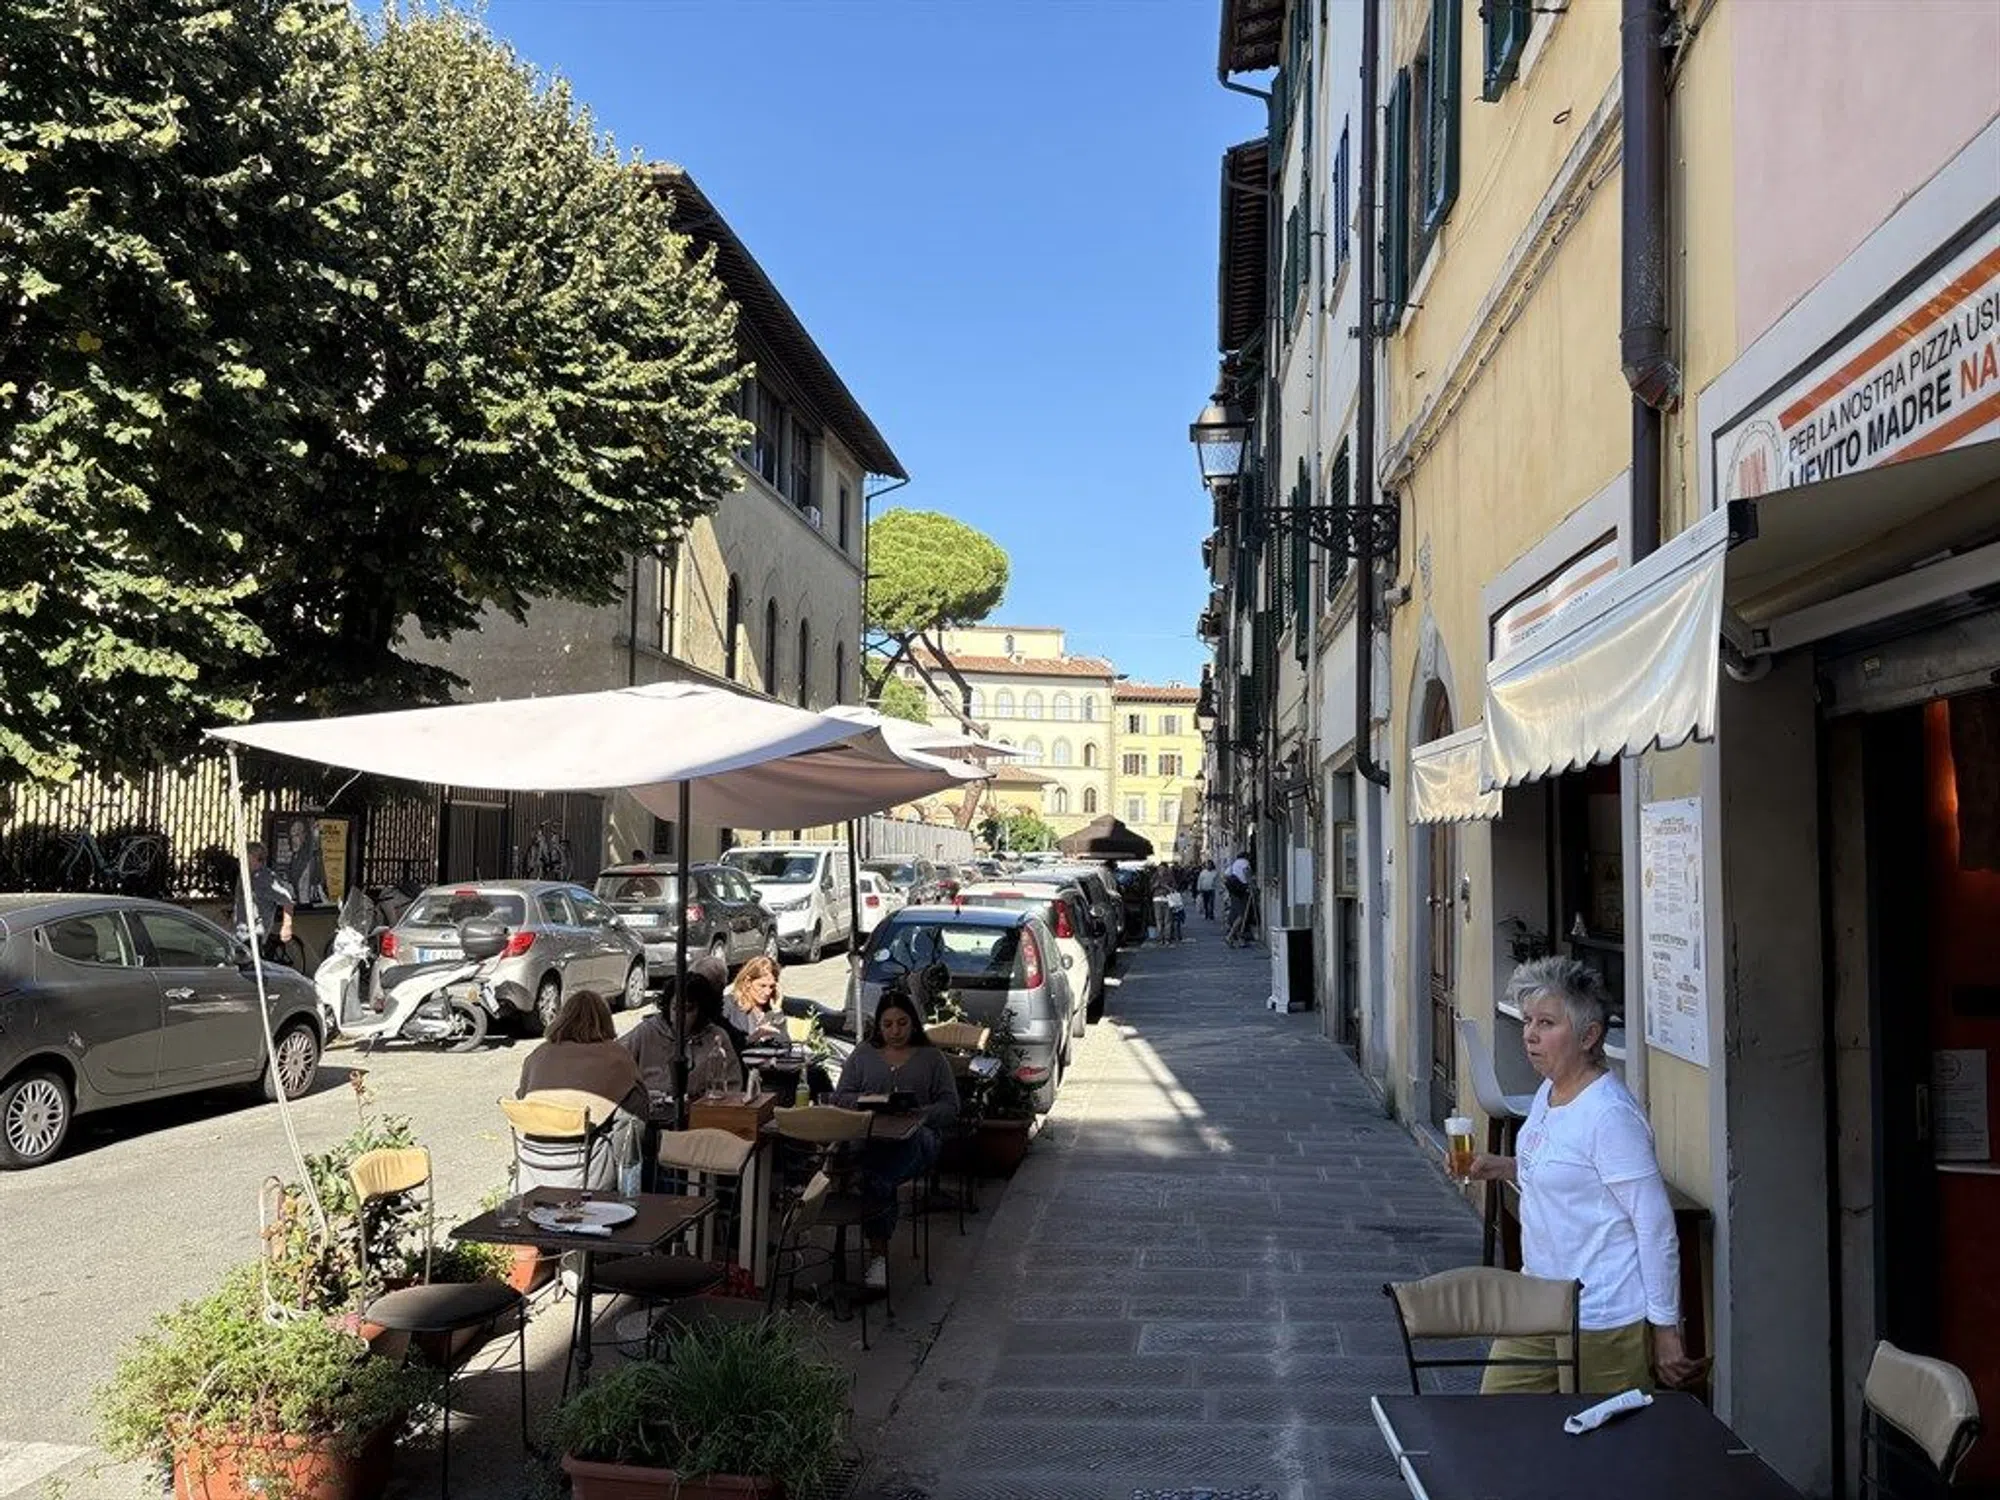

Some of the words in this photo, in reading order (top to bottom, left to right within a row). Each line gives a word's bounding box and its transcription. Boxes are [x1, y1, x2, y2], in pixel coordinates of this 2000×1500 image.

[1788, 423, 1816, 462] PER
[1819, 409, 1838, 442] LA
[1839, 362, 1906, 429] NOSTRA
[1909, 322, 1962, 382] PIZZA
[1965, 291, 2000, 342] USI
[1867, 368, 1952, 456] MADRE
[1960, 336, 2000, 400] NA
